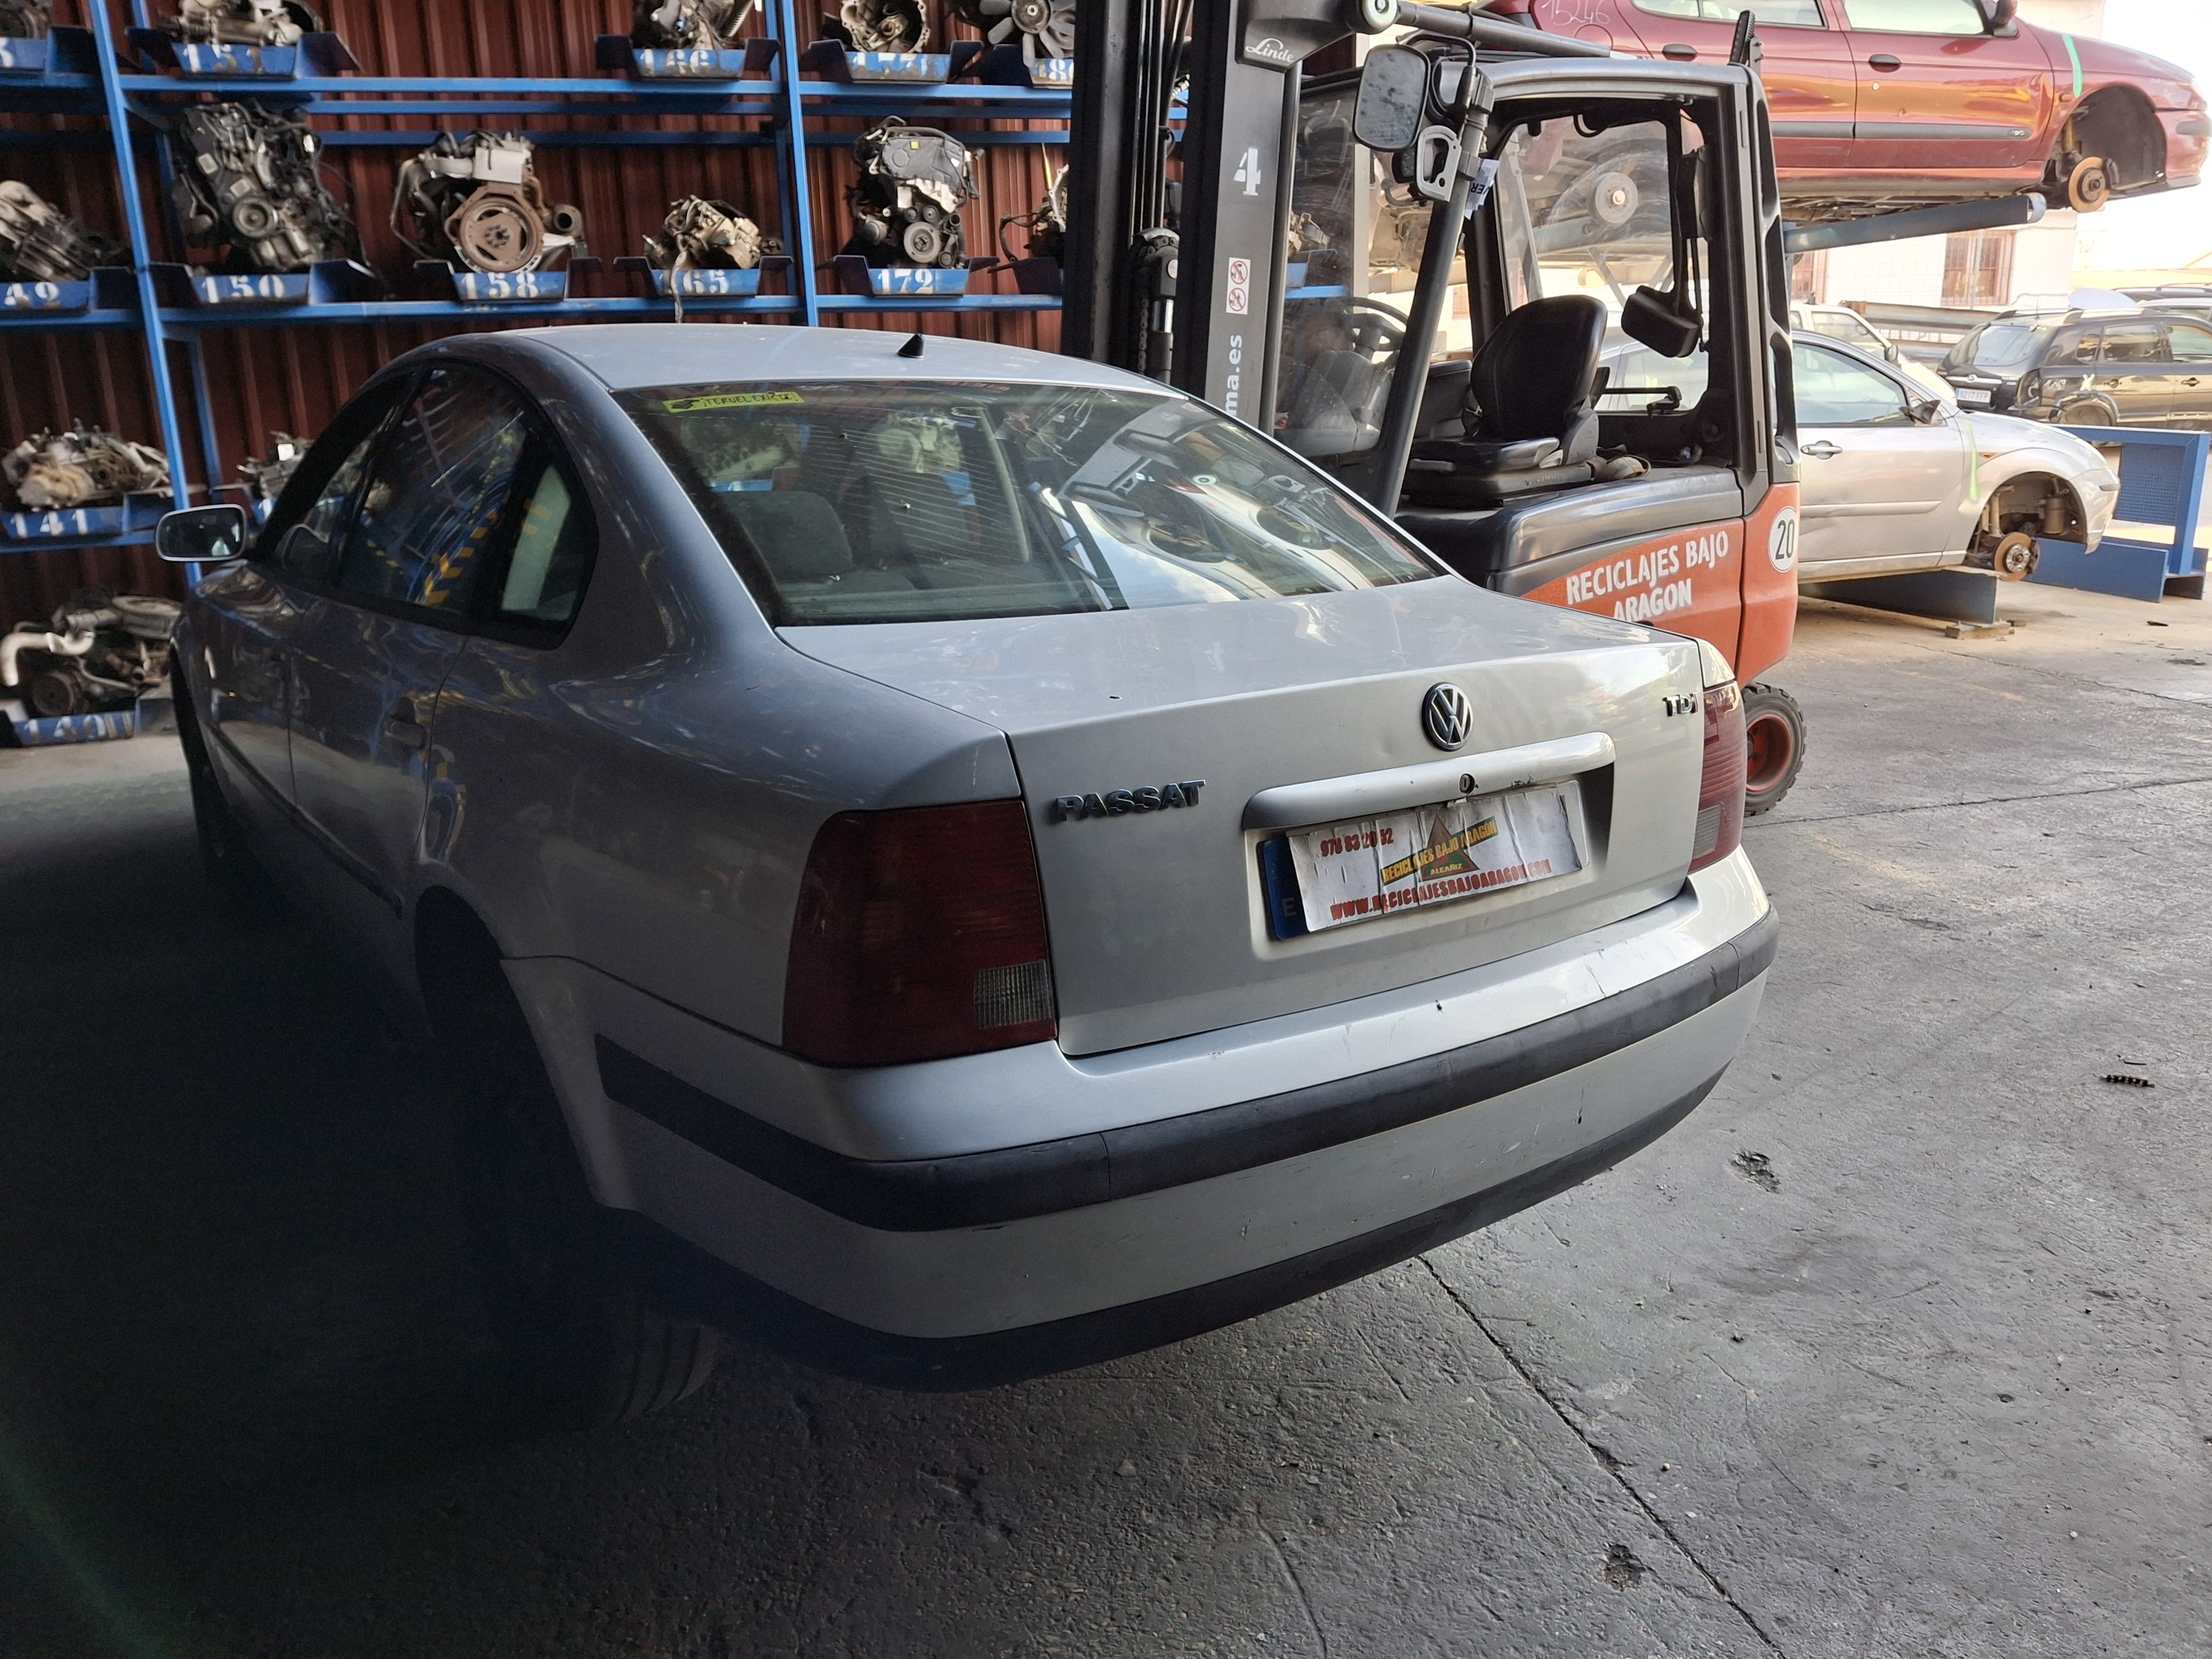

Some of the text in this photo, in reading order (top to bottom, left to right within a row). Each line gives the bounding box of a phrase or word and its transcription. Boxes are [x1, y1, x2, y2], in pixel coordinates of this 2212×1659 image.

[1245, 37, 1294, 62] Linde
[1233, 147, 1261, 196] 4
[202, 274, 285, 304] 150
[462, 272, 539, 300] 158
[659, 269, 729, 294] 165
[877, 269, 934, 294] 172
[1225, 335, 1243, 416] ma.es
[10, 509, 88, 538] 141
[1775, 519, 1795, 560] 20
[1566, 531, 1728, 605] RECICLAJES BAJO
[1614, 578, 1692, 622] ARAGON
[1663, 692, 1699, 717] TDI
[1056, 779, 1206, 822] PASSAT
[1320, 837, 1343, 857] 978
[1344, 834, 1360, 853] 83
[1361, 830, 1377, 849] 20
[1382, 848, 1435, 883] RECICLAJES
[1435, 838, 1459, 858] BAJO
[1430, 863, 1463, 876] ALCAÑIZ
